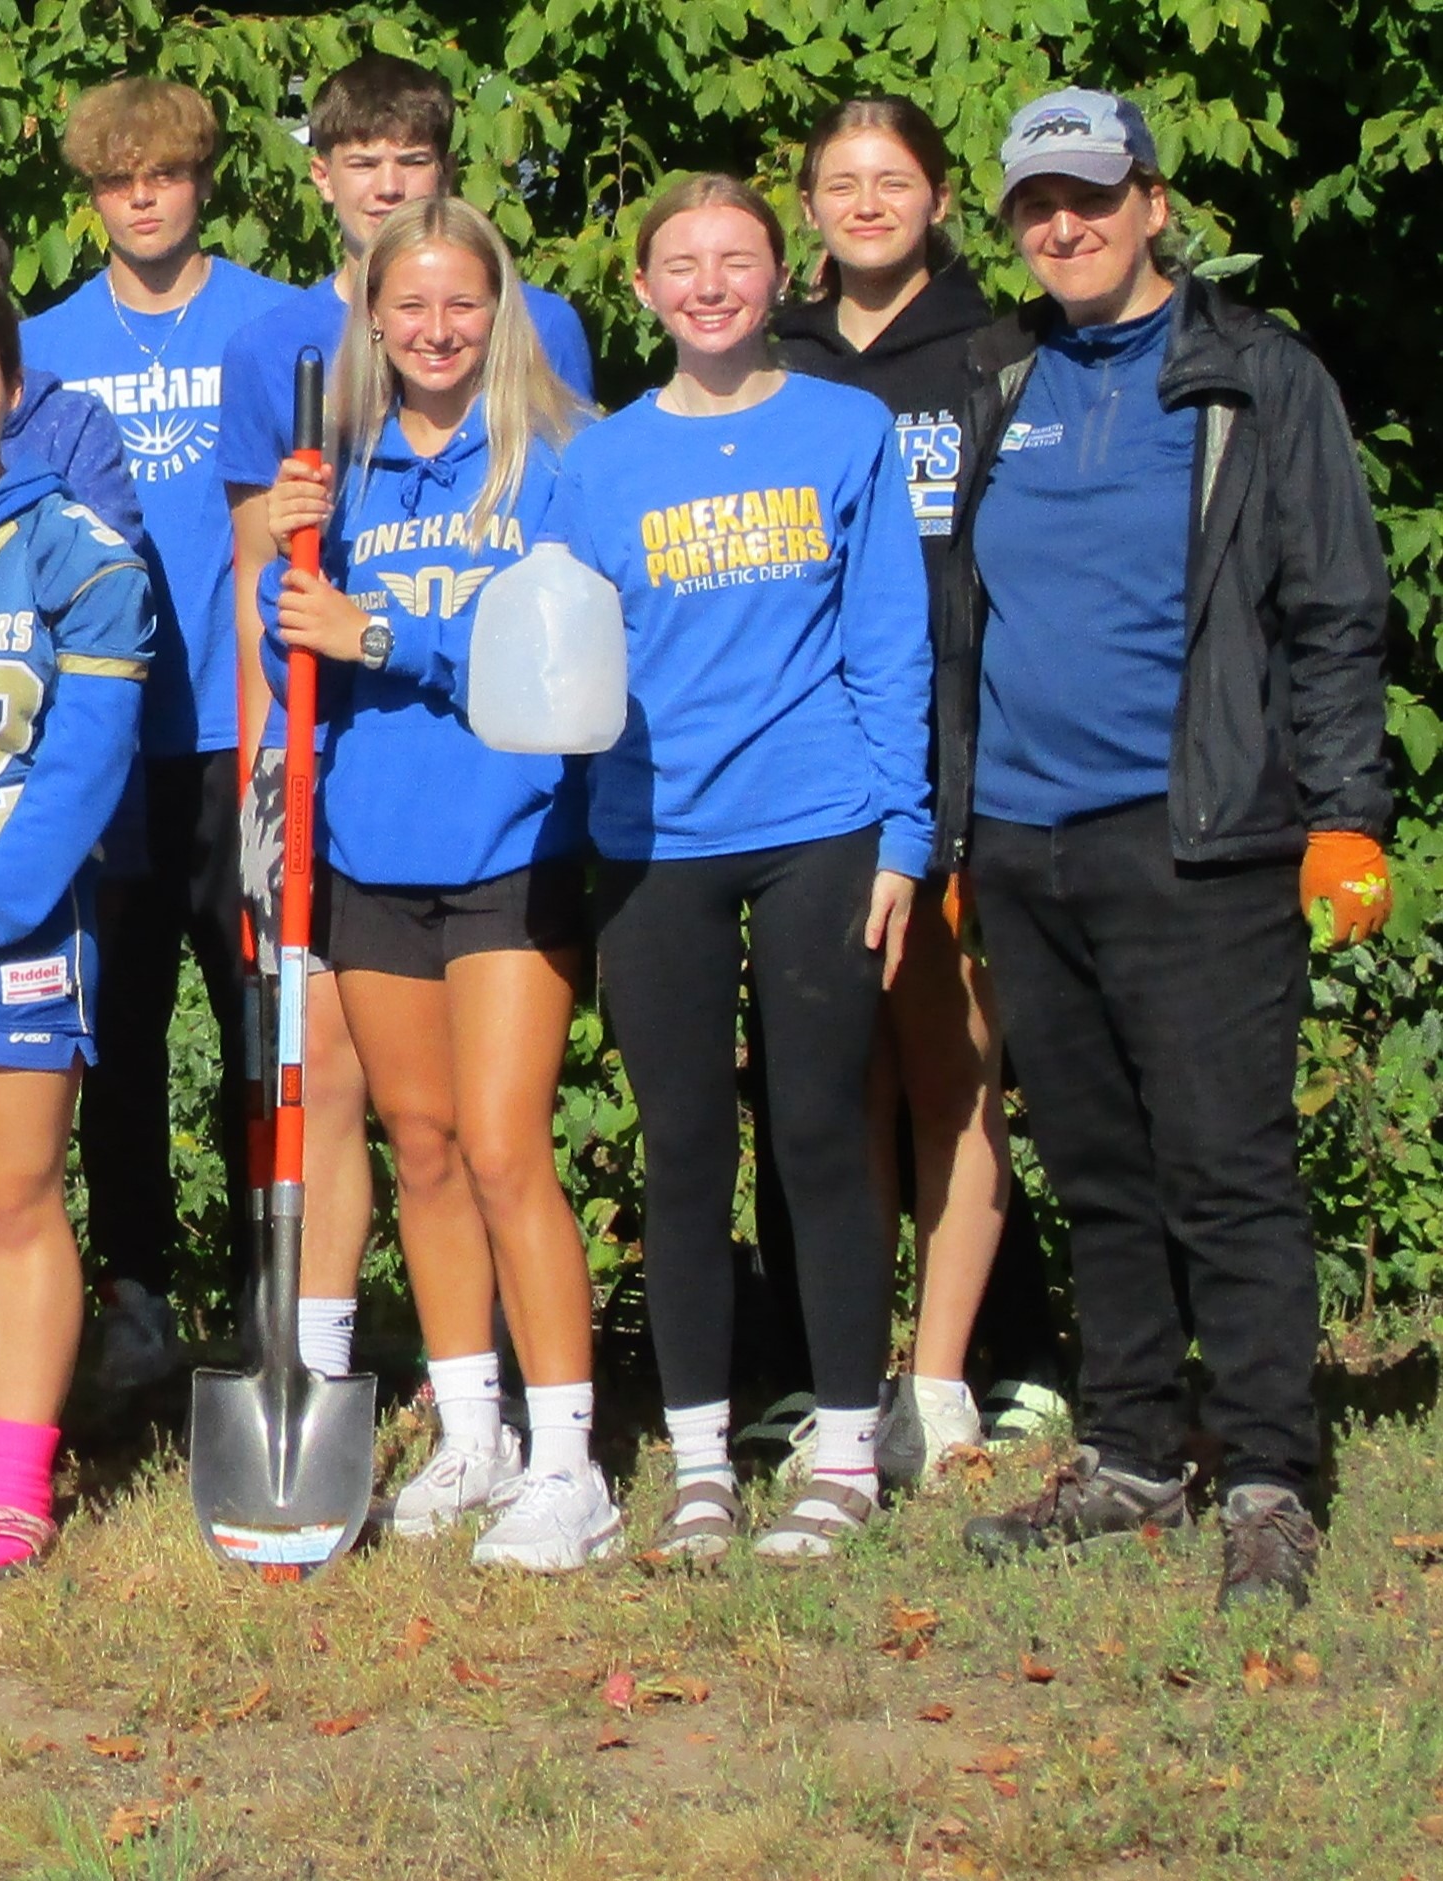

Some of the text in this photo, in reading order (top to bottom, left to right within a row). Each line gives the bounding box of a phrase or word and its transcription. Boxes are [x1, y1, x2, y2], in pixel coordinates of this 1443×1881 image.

[641, 486, 822, 551] ONEKAMA
[646, 528, 830, 588] PORTAGERS
[674, 563, 807, 598] ATHLETIC DEPT.
[348, 590, 388, 610] RACK
[9, 965, 60, 983] Riddell
